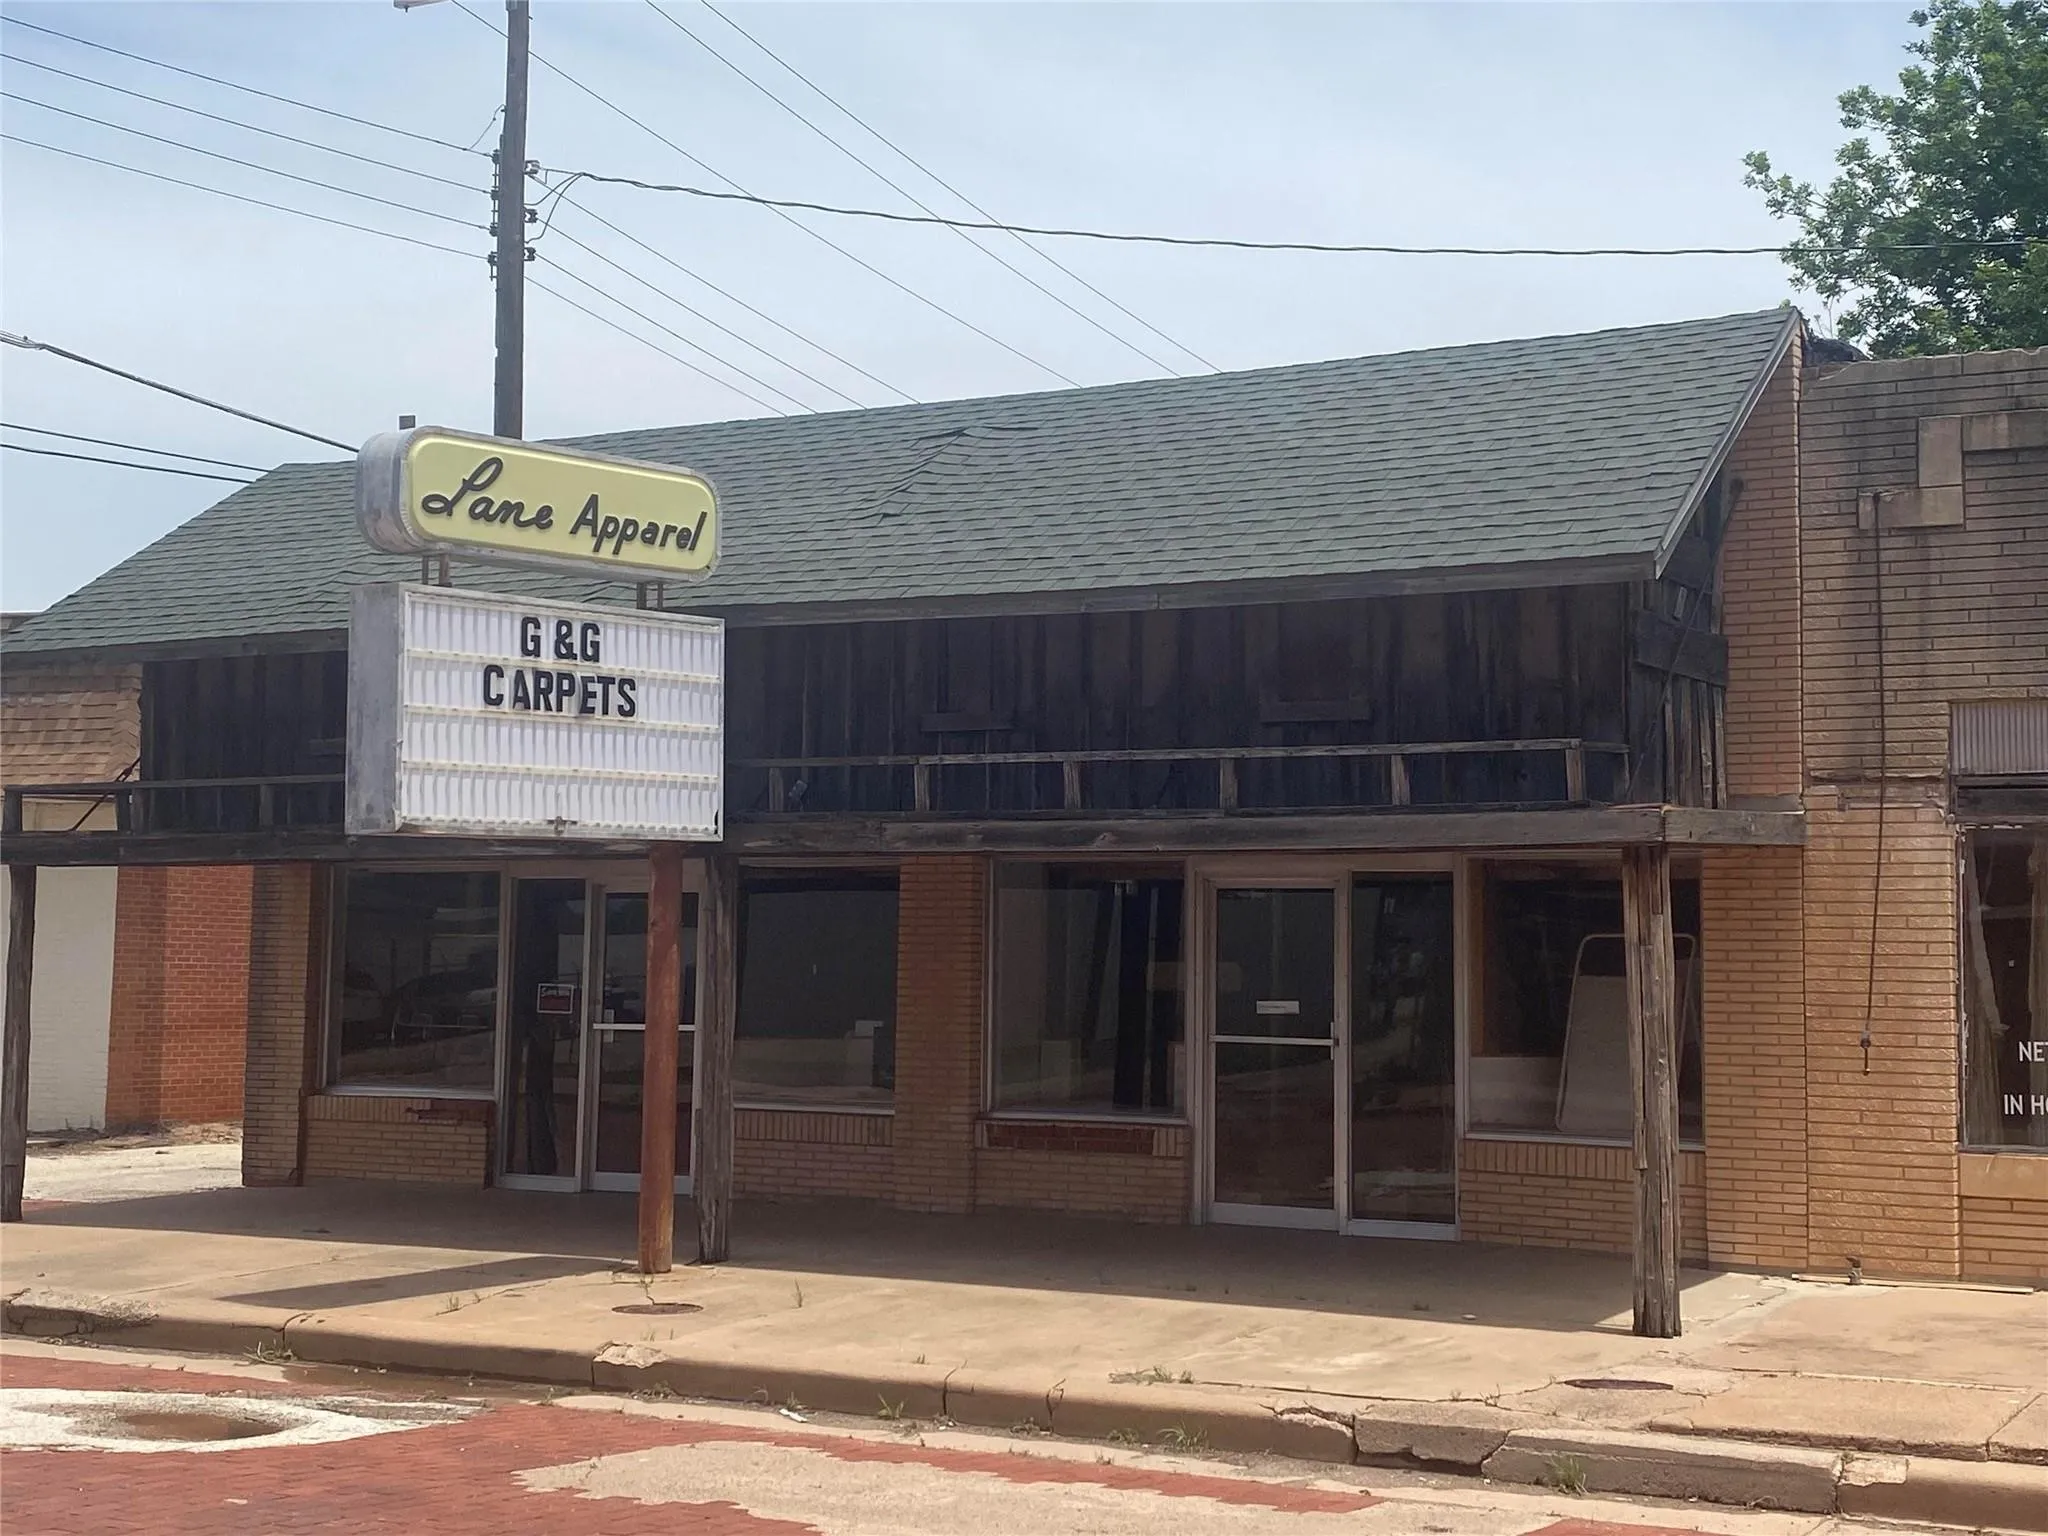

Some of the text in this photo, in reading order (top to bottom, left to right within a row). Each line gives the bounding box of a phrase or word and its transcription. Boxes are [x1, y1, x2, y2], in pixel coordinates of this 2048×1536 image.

[421, 456, 708, 555] Lane Apparel
[482, 664, 637, 718] CARPETS
[2003, 1094, 2048, 1116] IN H
